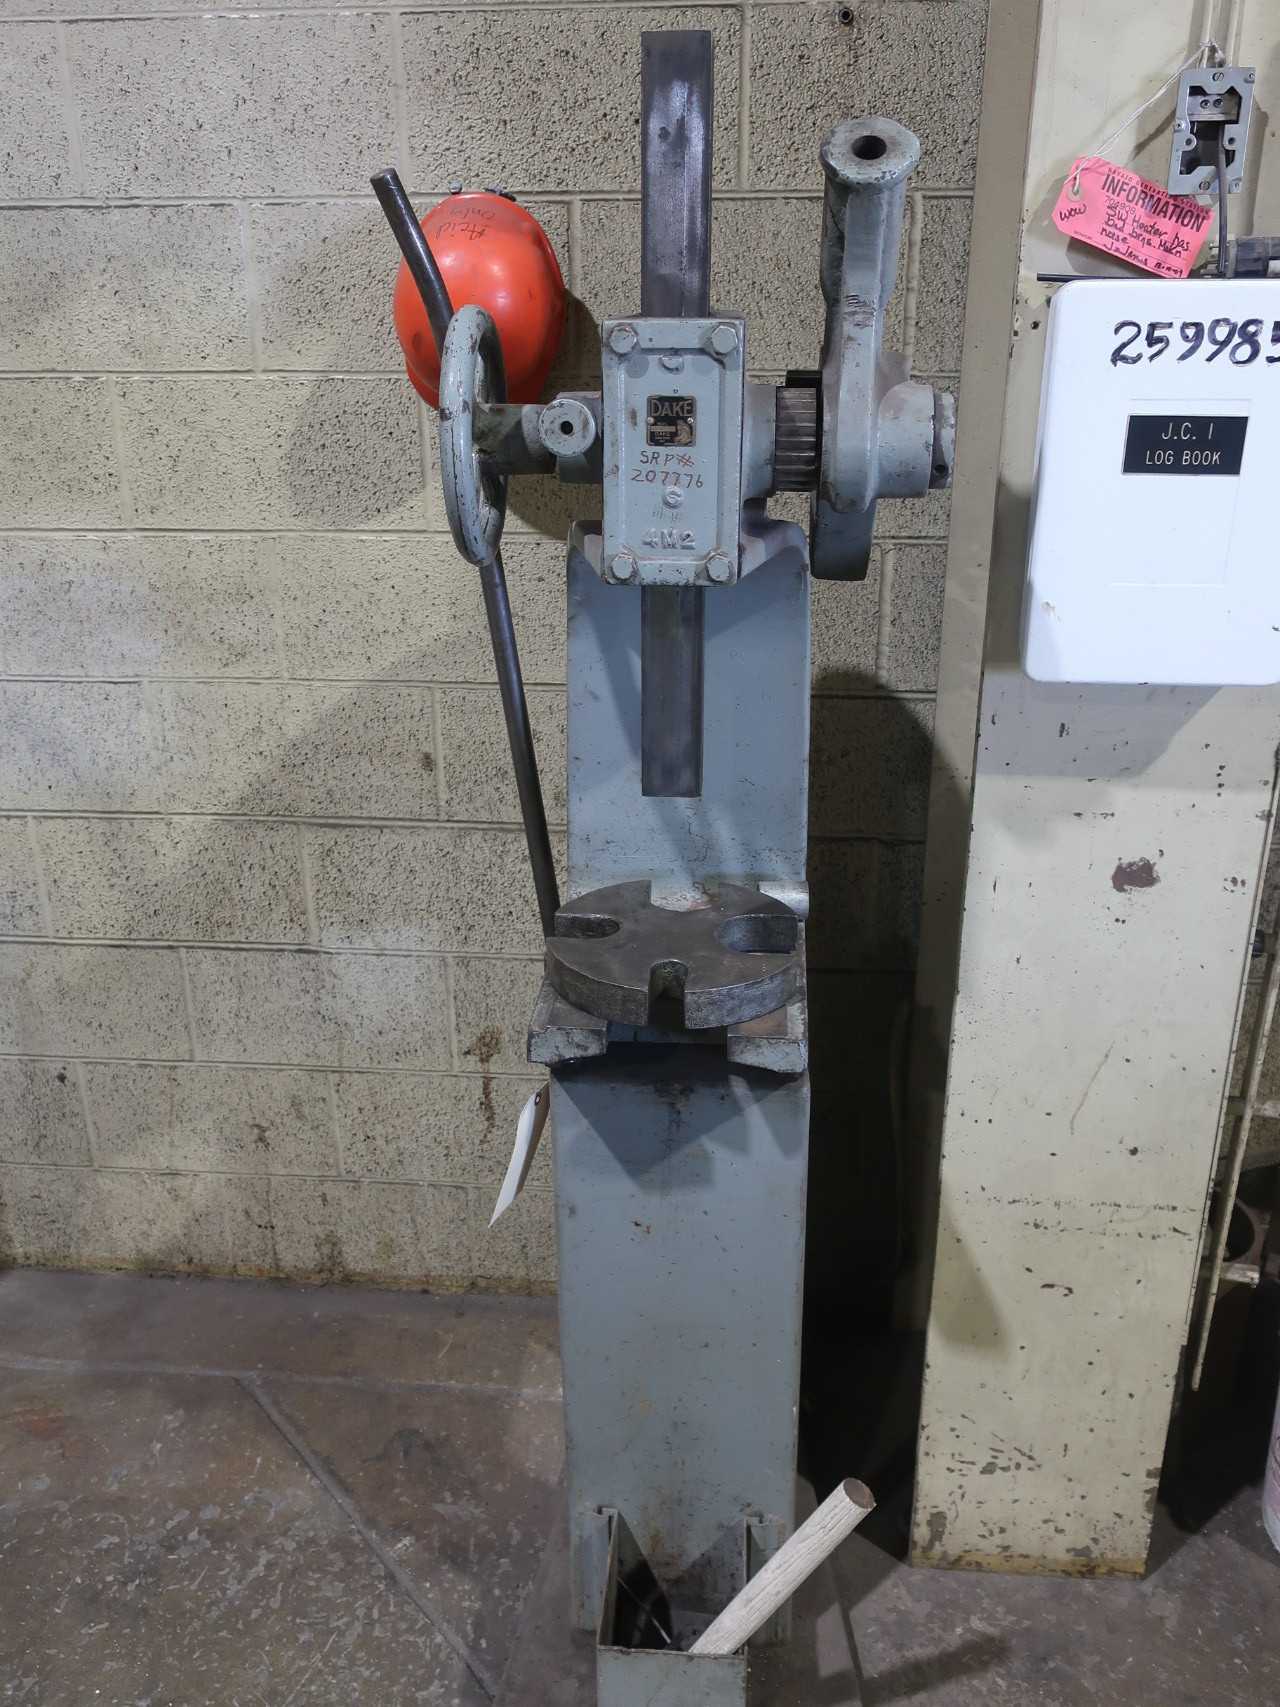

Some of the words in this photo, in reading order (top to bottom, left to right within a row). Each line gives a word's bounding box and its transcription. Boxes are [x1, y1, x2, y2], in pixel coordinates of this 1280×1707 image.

[1102, 174, 1206, 232] INFORMATION
[650, 399, 694, 417] DAKE
[1161, 422, 1197, 440] J.C.
[1145, 450, 1175, 465] LOG
[1182, 450, 1221, 466] BOOK
